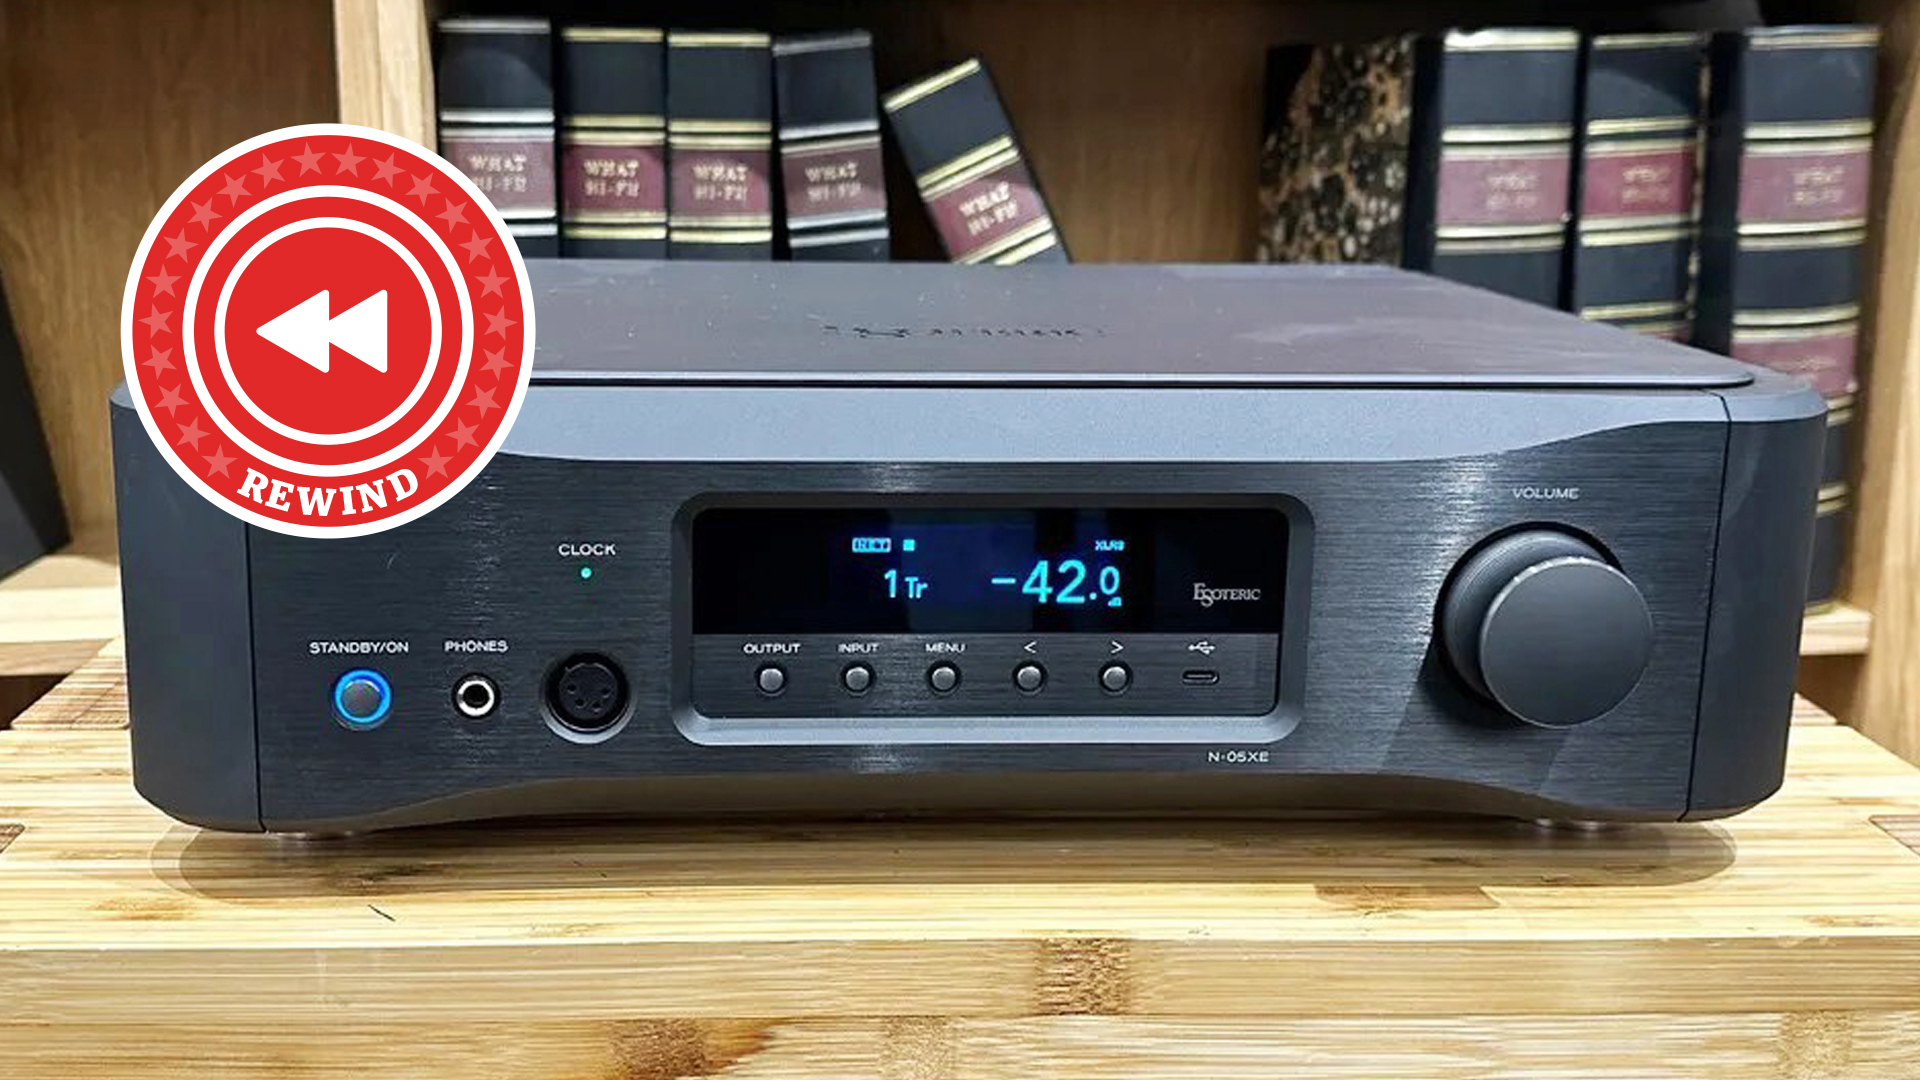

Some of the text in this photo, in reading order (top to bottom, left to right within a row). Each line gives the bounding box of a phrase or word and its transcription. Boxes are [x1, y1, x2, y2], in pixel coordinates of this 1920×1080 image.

[470, 154, 527, 171] WHAT
[584, 160, 639, 177] WHAT
[693, 163, 747, 181] WHAT
[805, 162, 859, 182] WHAT
[959, 181, 1010, 217] WHAT
[1512, 486, 1580, 499] VOLUME
[558, 543, 616, 556] CLOCK
[309, 641, 409, 654] STANDBY/ON
[444, 640, 509, 653] PHONES
[743, 643, 800, 654] OUTPUT
[837, 643, 879, 653] INPUT
[925, 643, 965, 653] MENU
